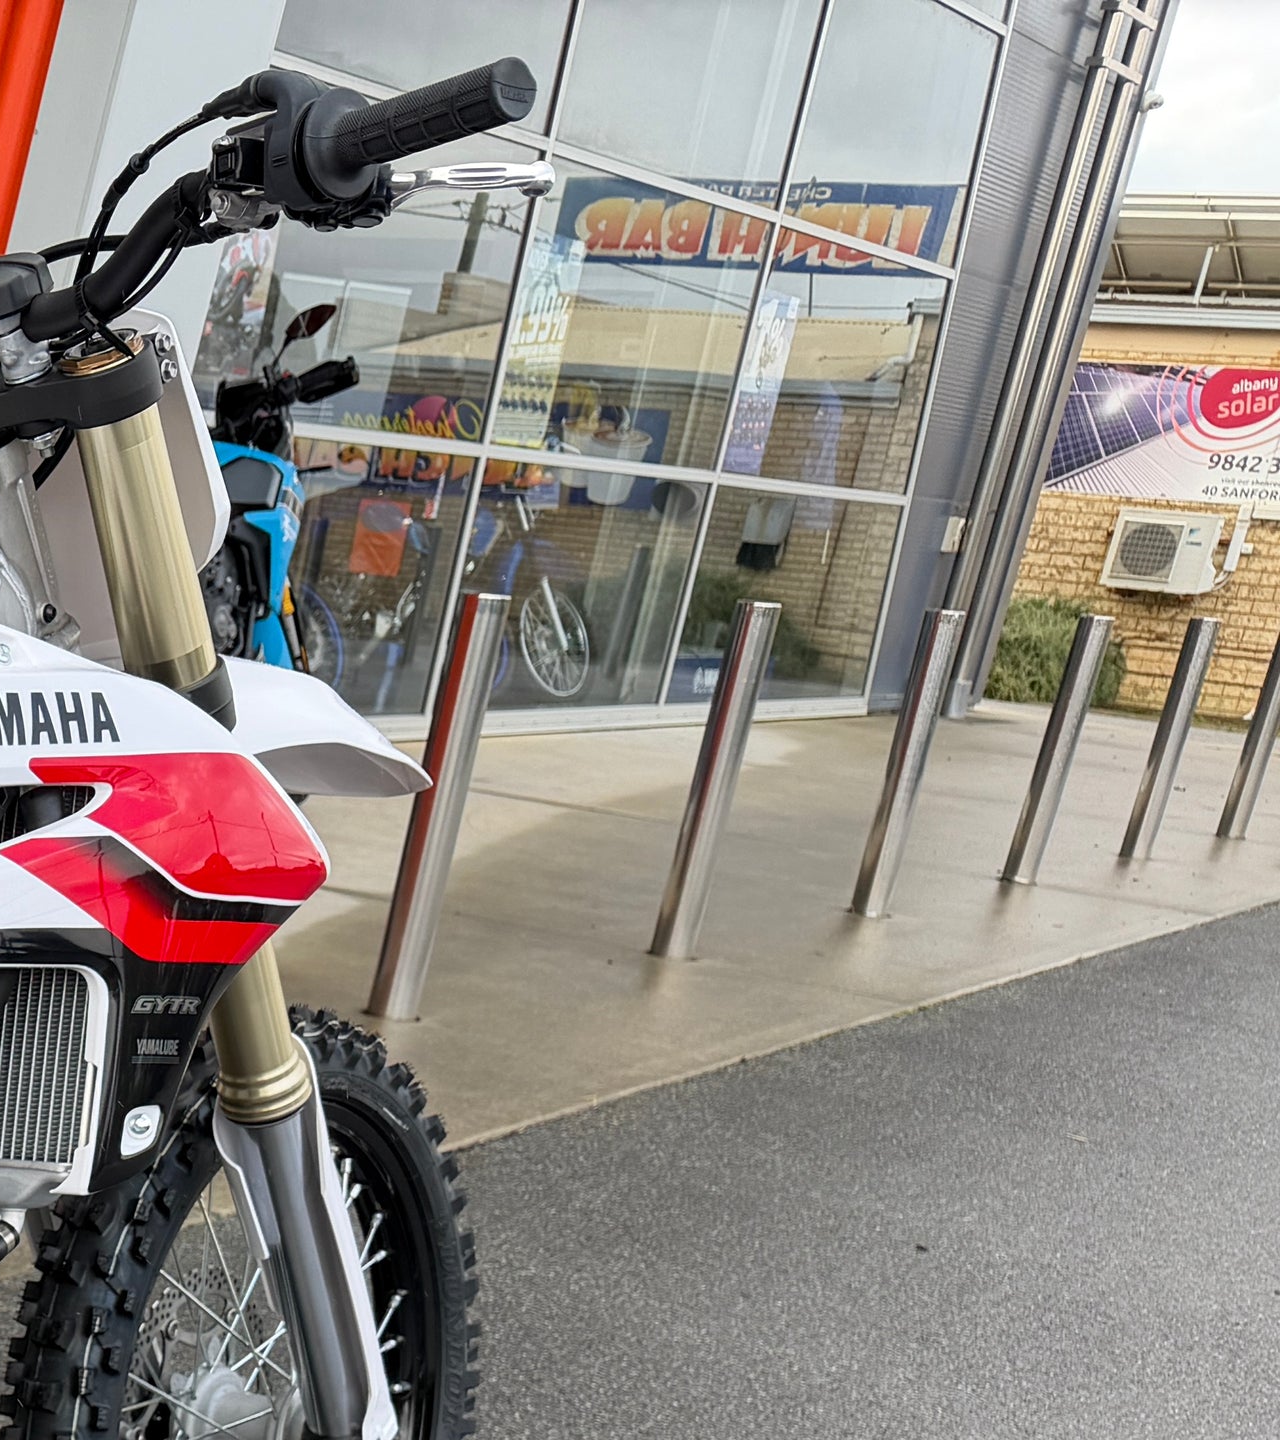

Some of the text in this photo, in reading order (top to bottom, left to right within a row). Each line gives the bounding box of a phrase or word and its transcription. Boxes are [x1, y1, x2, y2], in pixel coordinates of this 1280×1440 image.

[1231, 376, 1279, 395] albany
[1217, 392, 1280, 419] solar
[1207, 453, 1263, 473] 9842
[1201, 486, 1218, 496] 40
[130, 994, 202, 1016] GYTR
[136, 1038, 181, 1056] YAMALUBE
